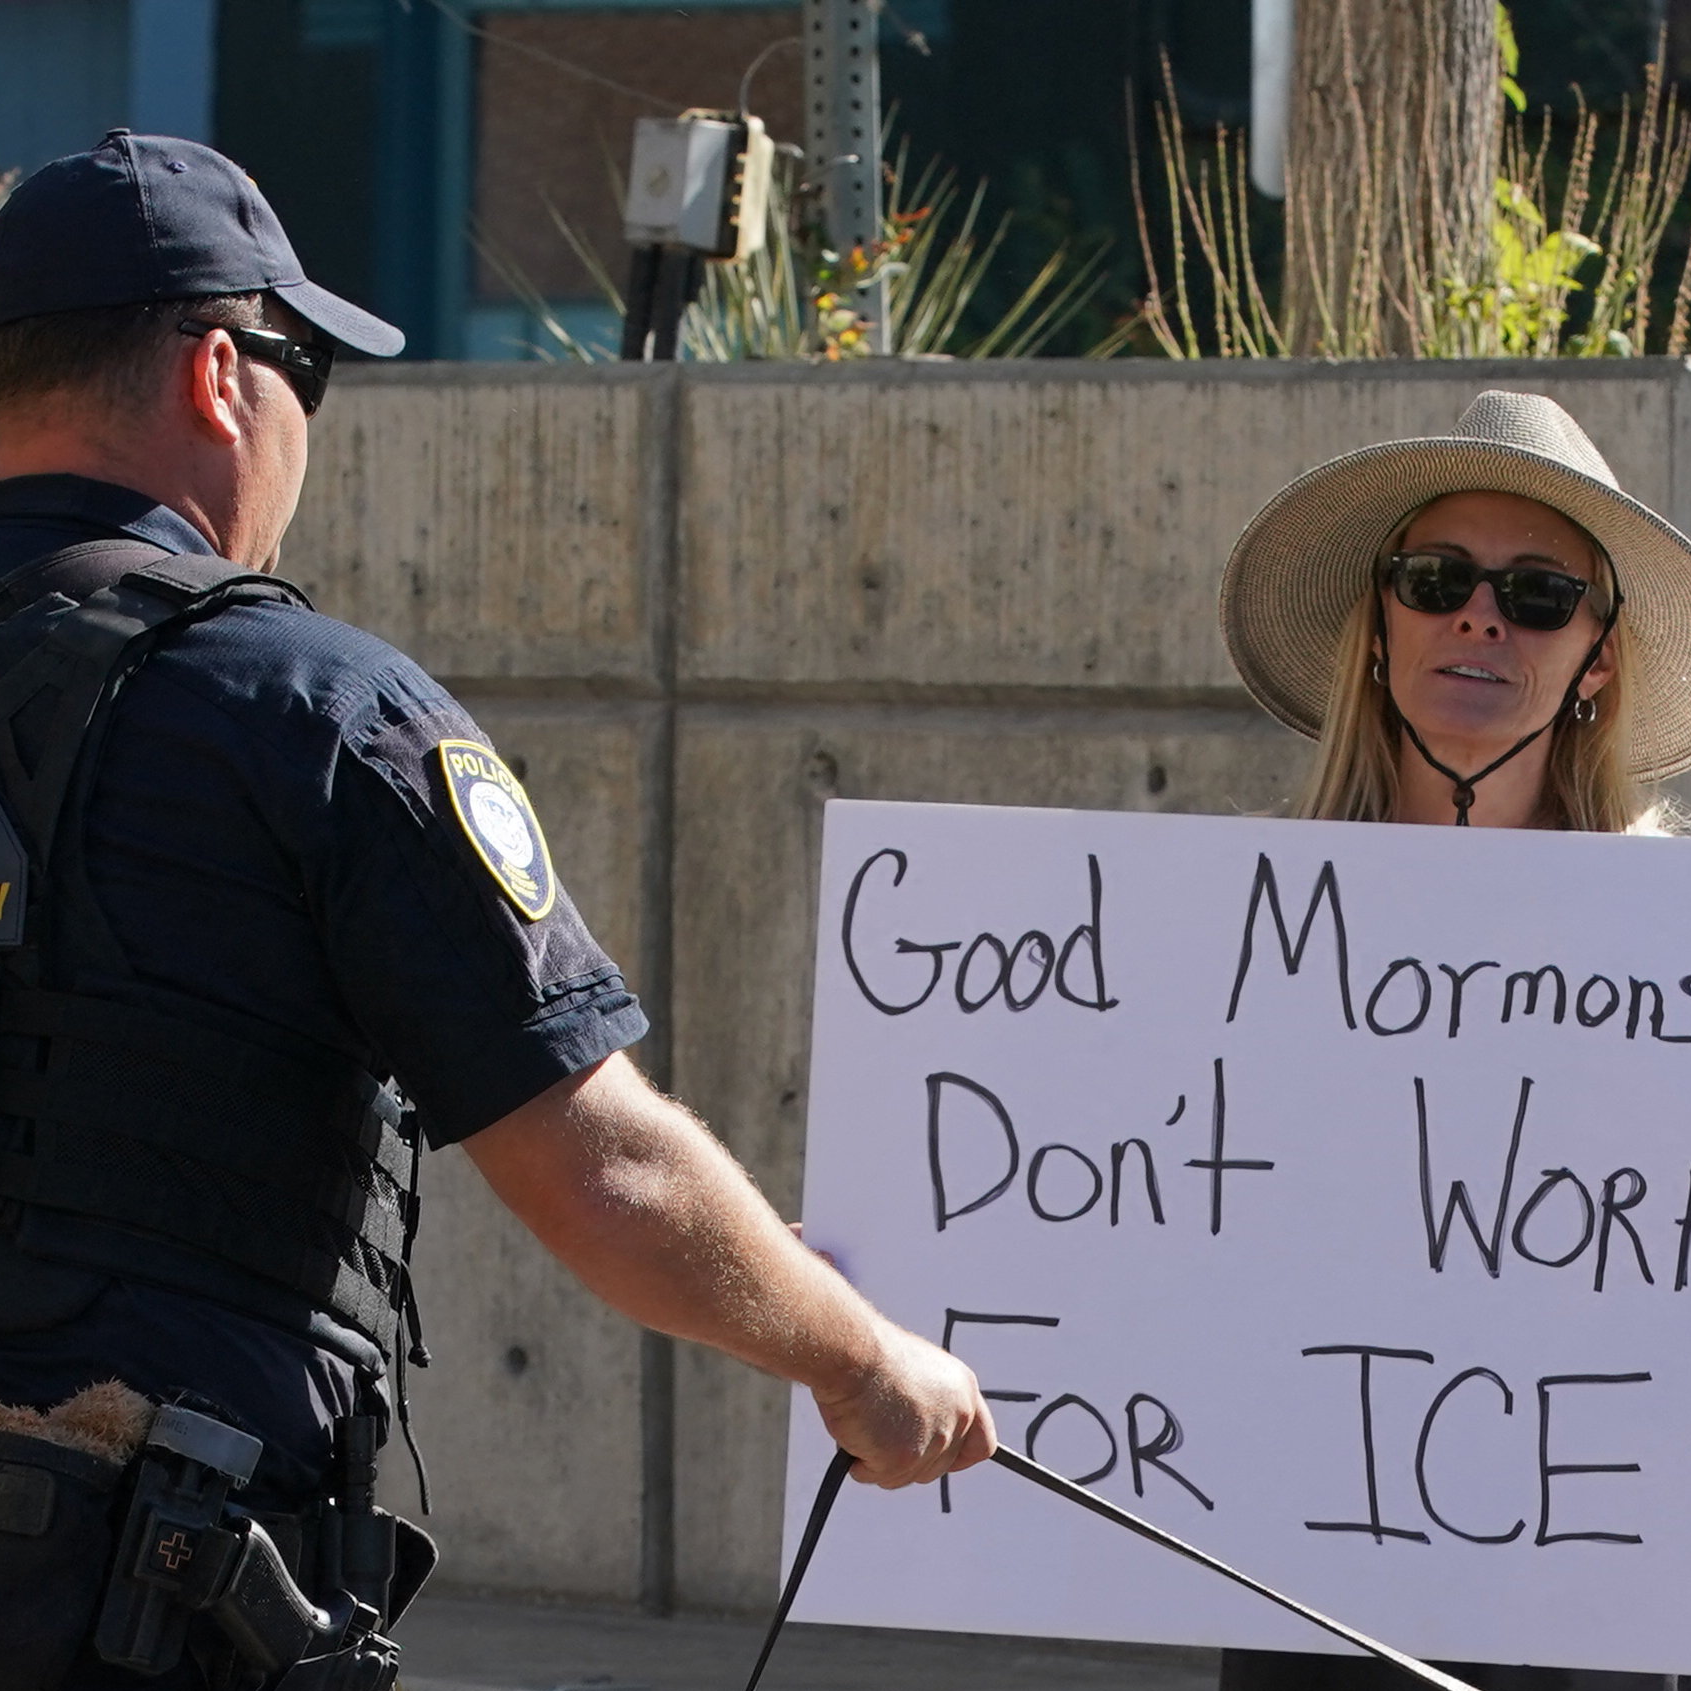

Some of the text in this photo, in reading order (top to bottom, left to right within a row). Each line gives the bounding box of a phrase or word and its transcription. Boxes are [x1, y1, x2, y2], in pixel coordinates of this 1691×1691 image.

[449, 753, 525, 807] POLICE
[841, 847, 1120, 1015] Good
[925, 1057, 1275, 1236] Don't
[941, 1307, 1653, 1546] FOR ICE
